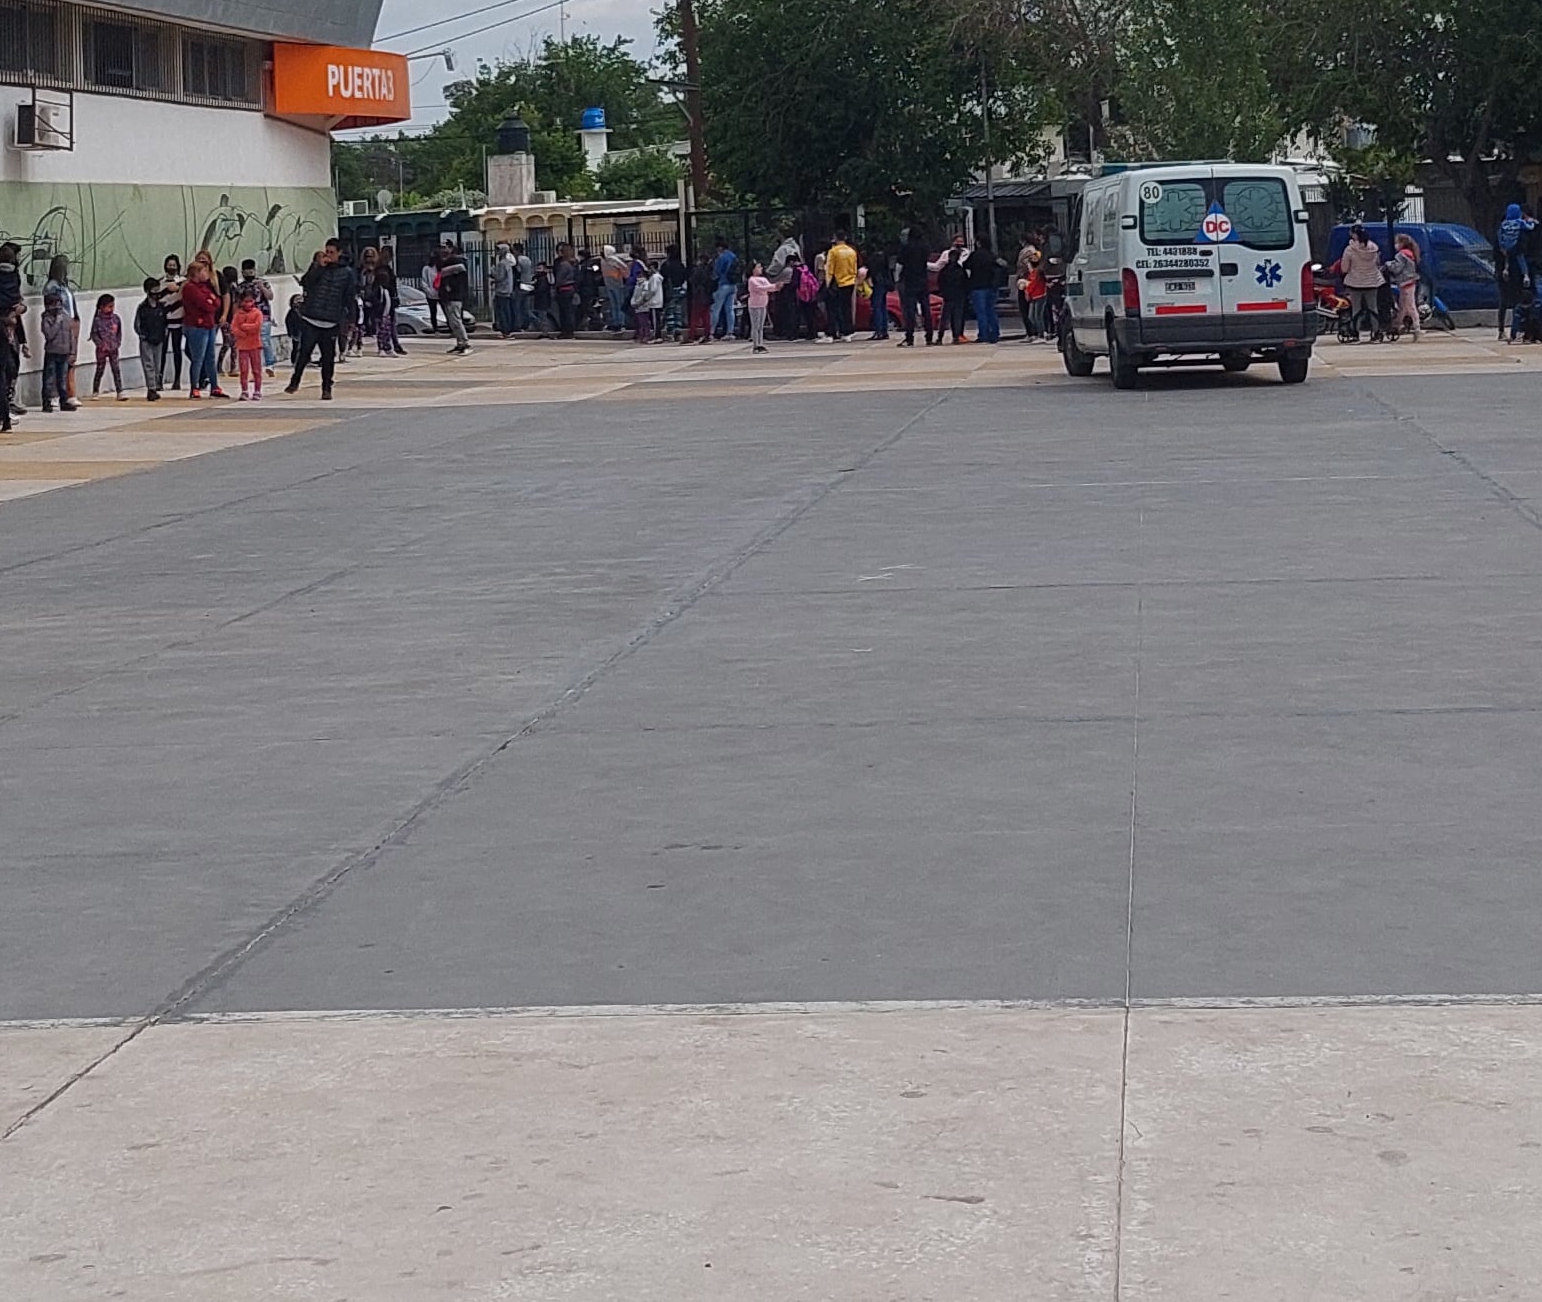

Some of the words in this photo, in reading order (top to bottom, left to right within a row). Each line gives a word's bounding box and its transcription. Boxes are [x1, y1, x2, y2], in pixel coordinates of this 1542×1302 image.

[1144, 186, 1160, 200] 80
[1206, 221, 1229, 233] DC
[1147, 248, 1161, 256] TEL:
[1136, 260, 1151, 268] CEL:
